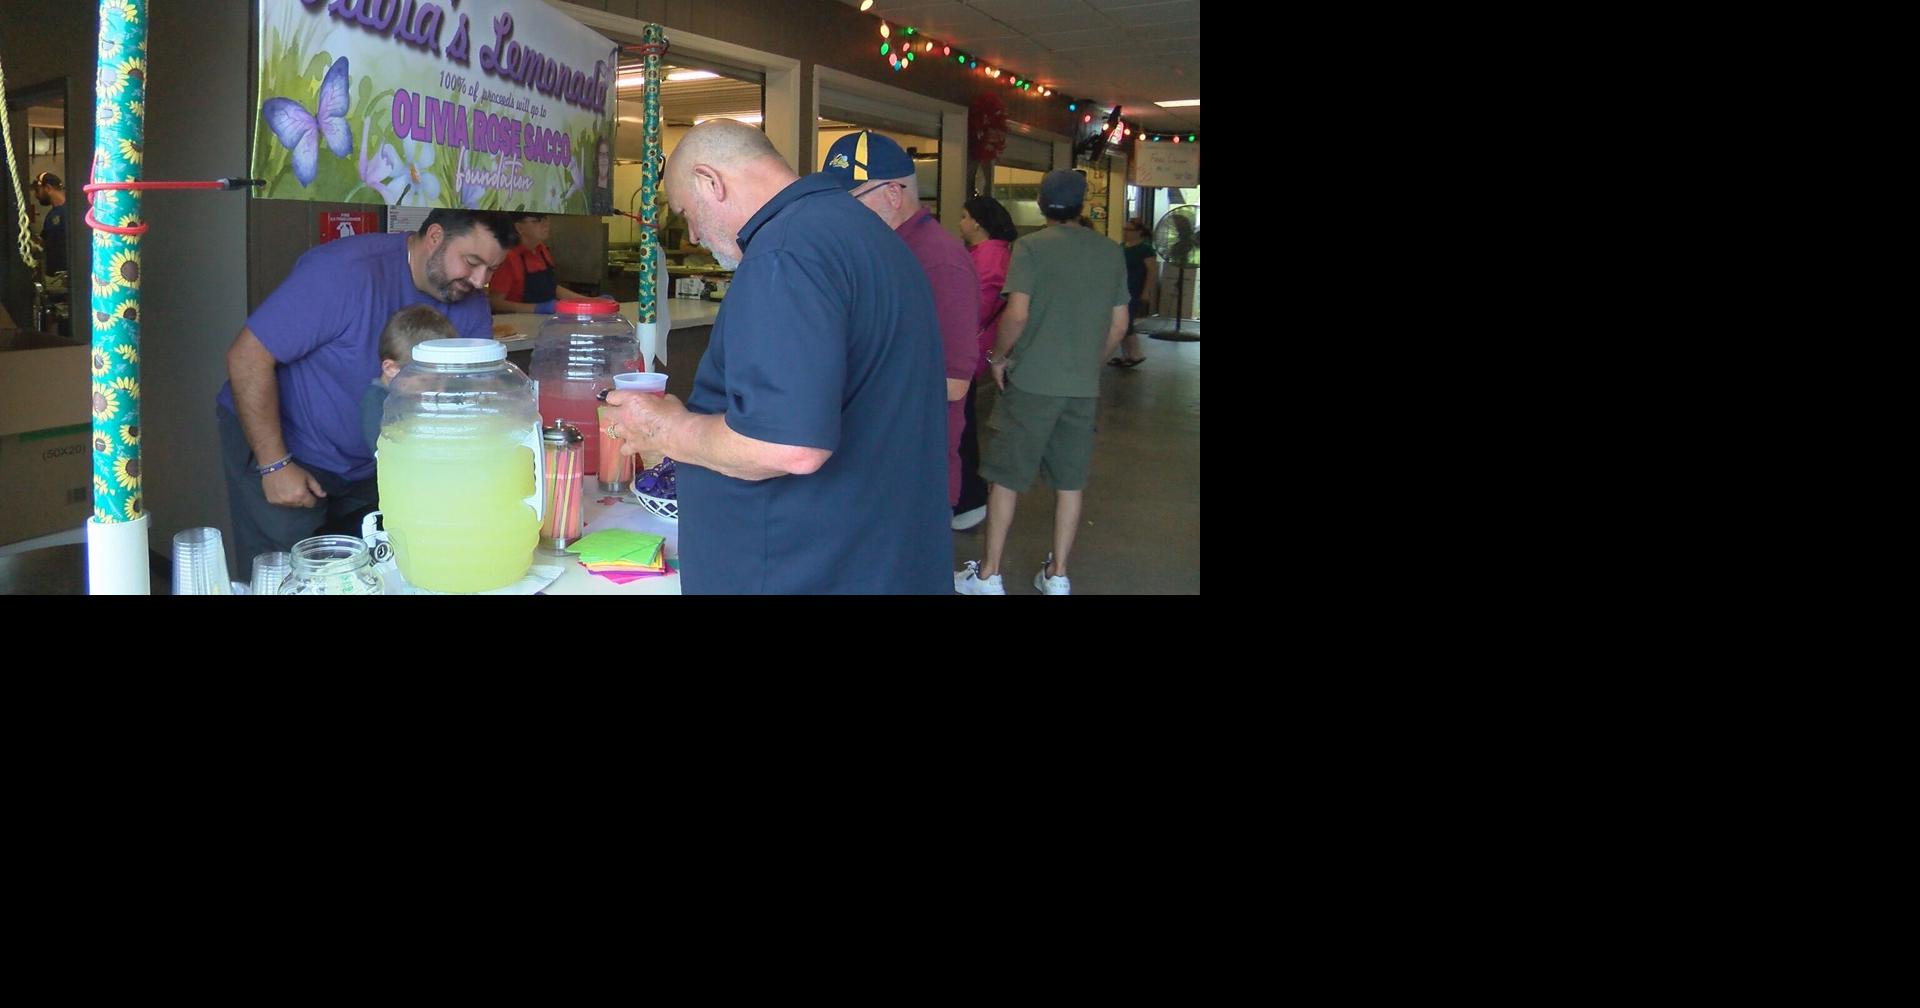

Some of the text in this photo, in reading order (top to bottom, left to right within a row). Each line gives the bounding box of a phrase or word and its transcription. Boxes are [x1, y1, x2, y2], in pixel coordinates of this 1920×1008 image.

[440, 70, 547, 118] 100% of proceeds will go to
[392, 88, 571, 169] OLIVIA ROSE SACCO
[455, 145, 533, 201] foundation
